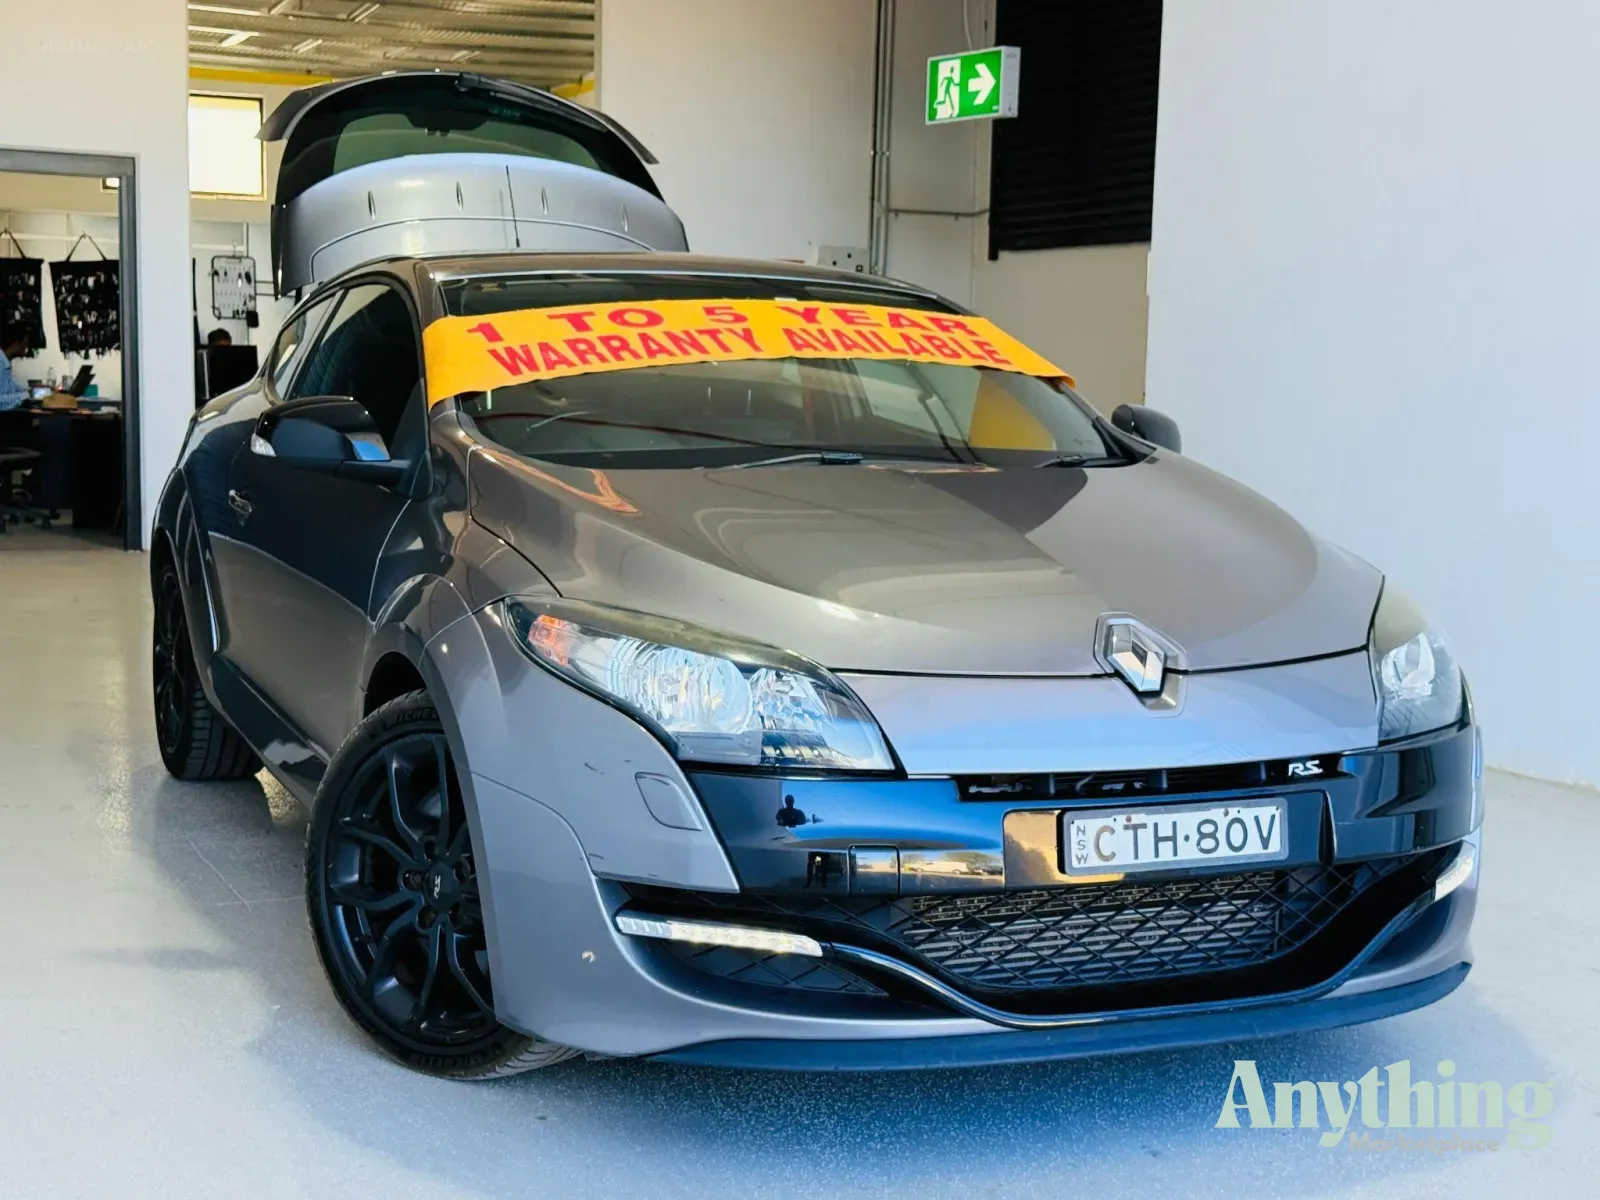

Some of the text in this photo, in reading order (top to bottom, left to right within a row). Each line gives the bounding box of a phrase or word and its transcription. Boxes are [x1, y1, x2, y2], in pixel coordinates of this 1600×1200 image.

[466, 306, 980, 344] 1 TO 5 YEAR
[487, 327, 1012, 377] WARRANTY AVAILABLE
[1288, 760, 1323, 776] RS
